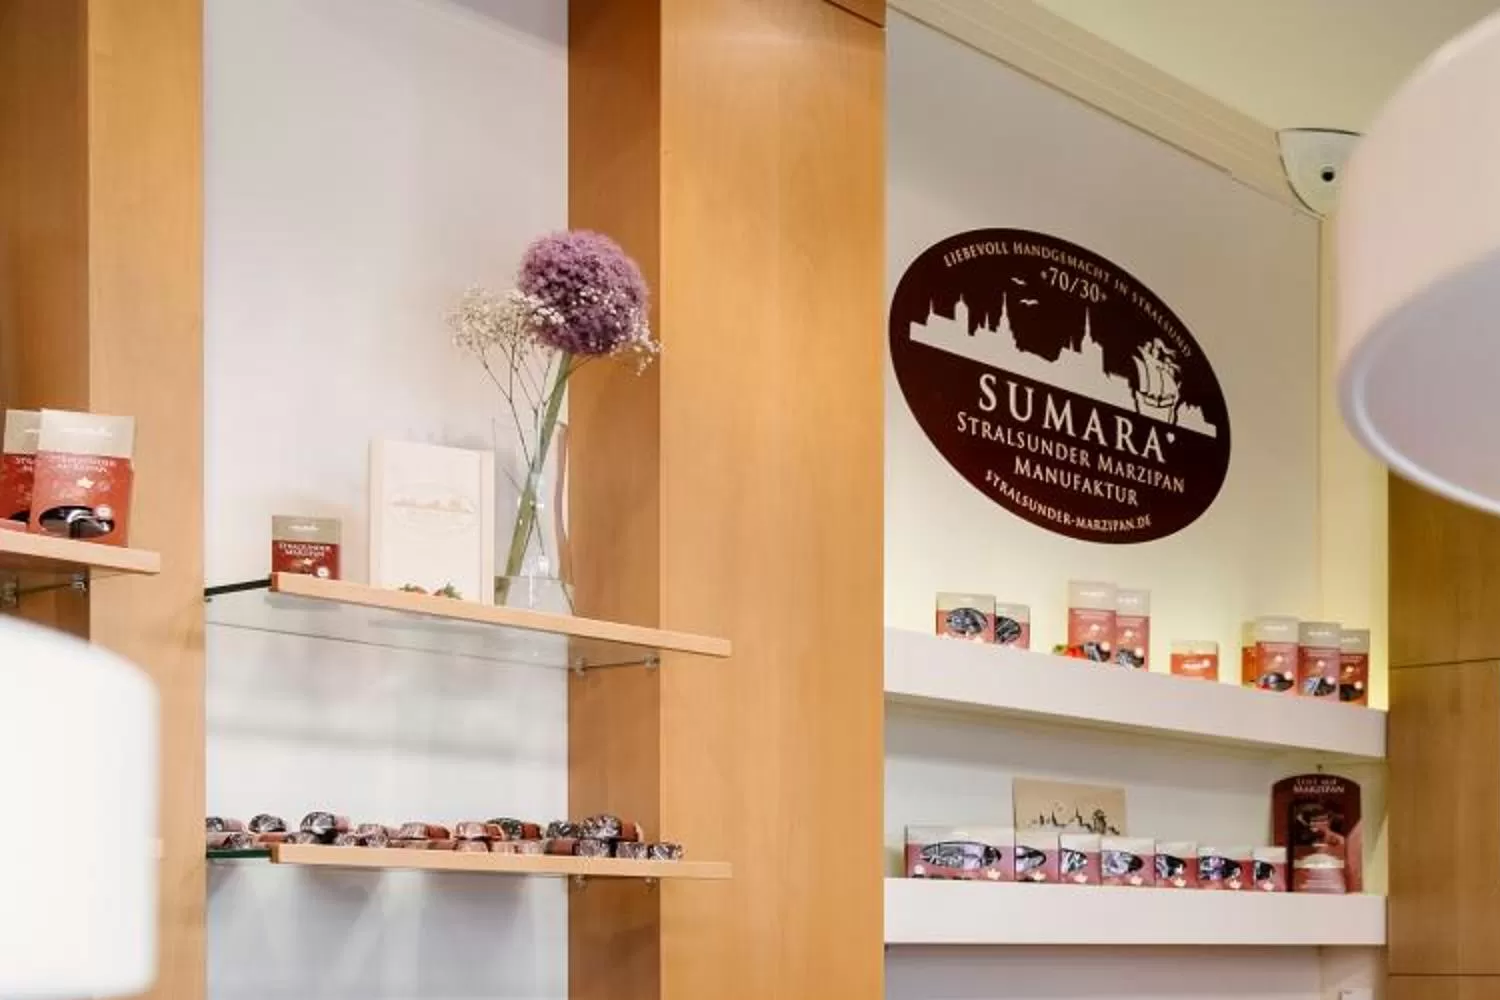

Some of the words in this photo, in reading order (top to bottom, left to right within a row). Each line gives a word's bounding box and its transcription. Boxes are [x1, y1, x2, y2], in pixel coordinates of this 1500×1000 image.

[943, 241, 1008, 267] LIEBEVOLL
[1013, 241, 1111, 284] HANDGEMACHT
[1115, 279, 1129, 296] IN
[1132, 291, 1192, 357] STRALSUND
[957, 411, 1091, 468] STRALSUNDER
[1097, 453, 1185, 493] MARZIPAN
[978, 373, 1167, 463] SUMARA
[985, 469, 1152, 532] STRALSUNDER-MARZIPAN.DE
[1014, 455, 1139, 506] MANUFAKTUR
